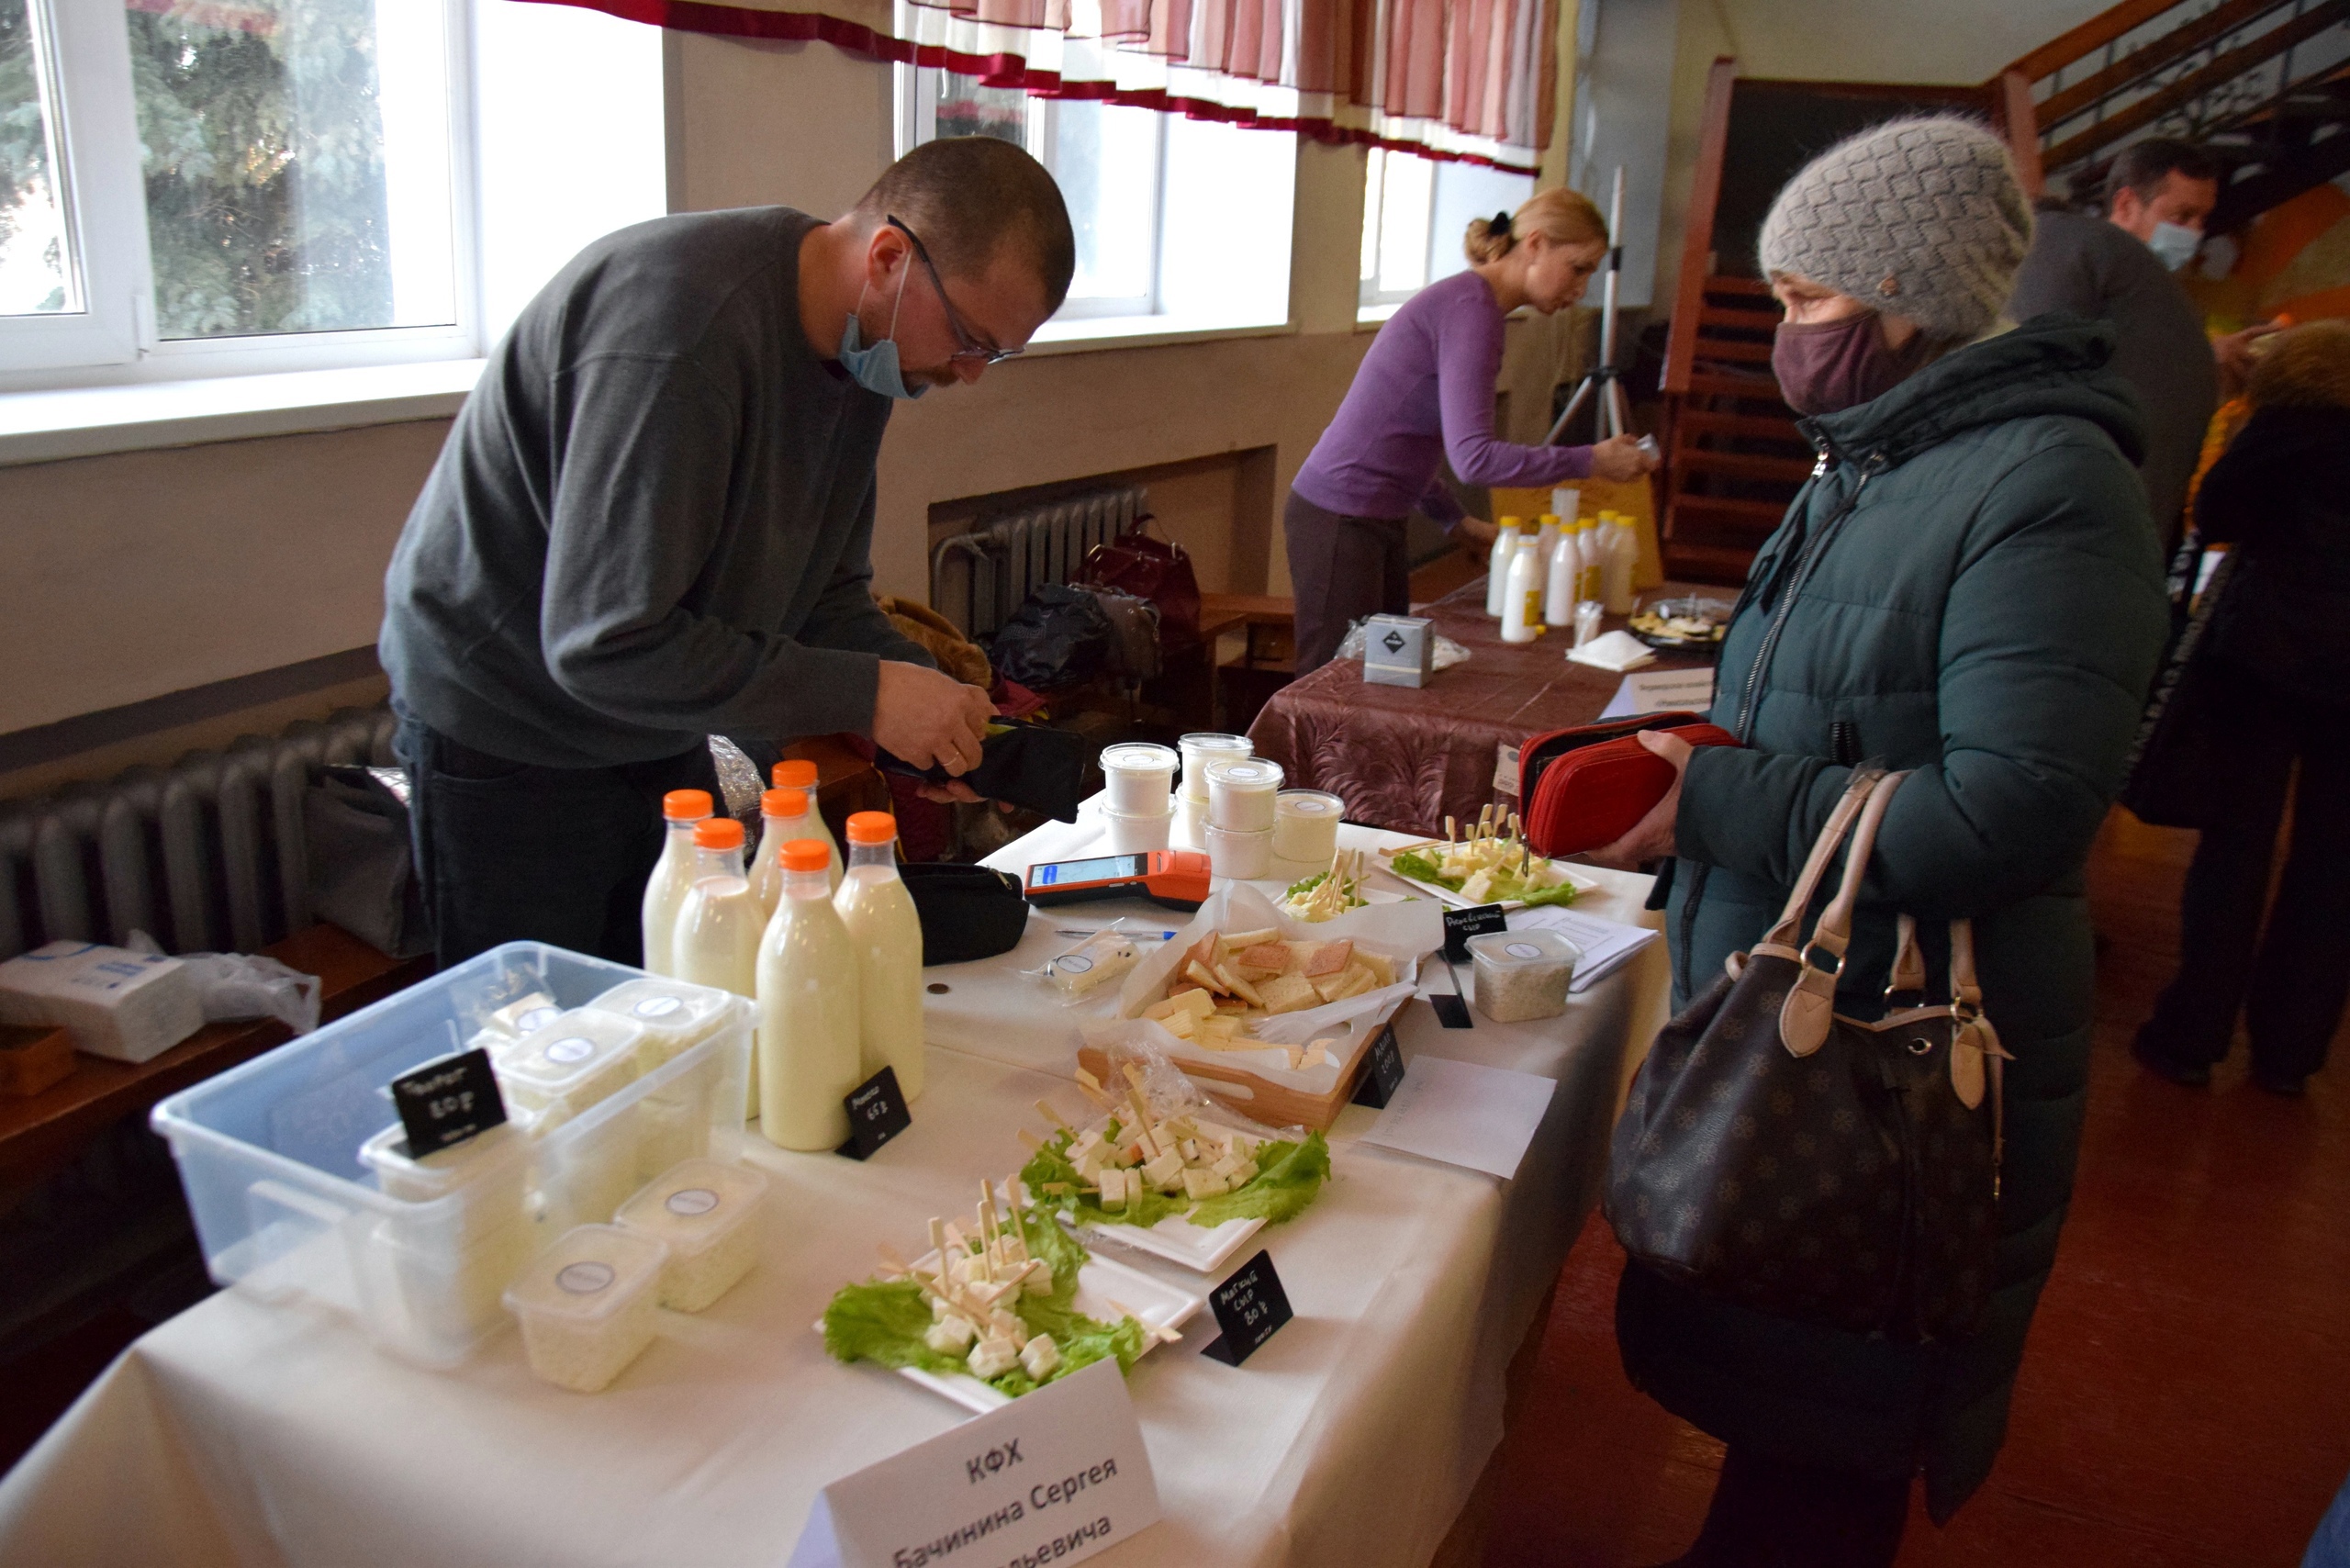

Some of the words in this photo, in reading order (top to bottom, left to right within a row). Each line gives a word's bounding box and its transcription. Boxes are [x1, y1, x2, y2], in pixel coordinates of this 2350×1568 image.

[965, 1438, 1025, 1484] КФХ
[892, 1500, 1025, 1568] Бачинина
[1031, 1457, 1119, 1509] Сергея
